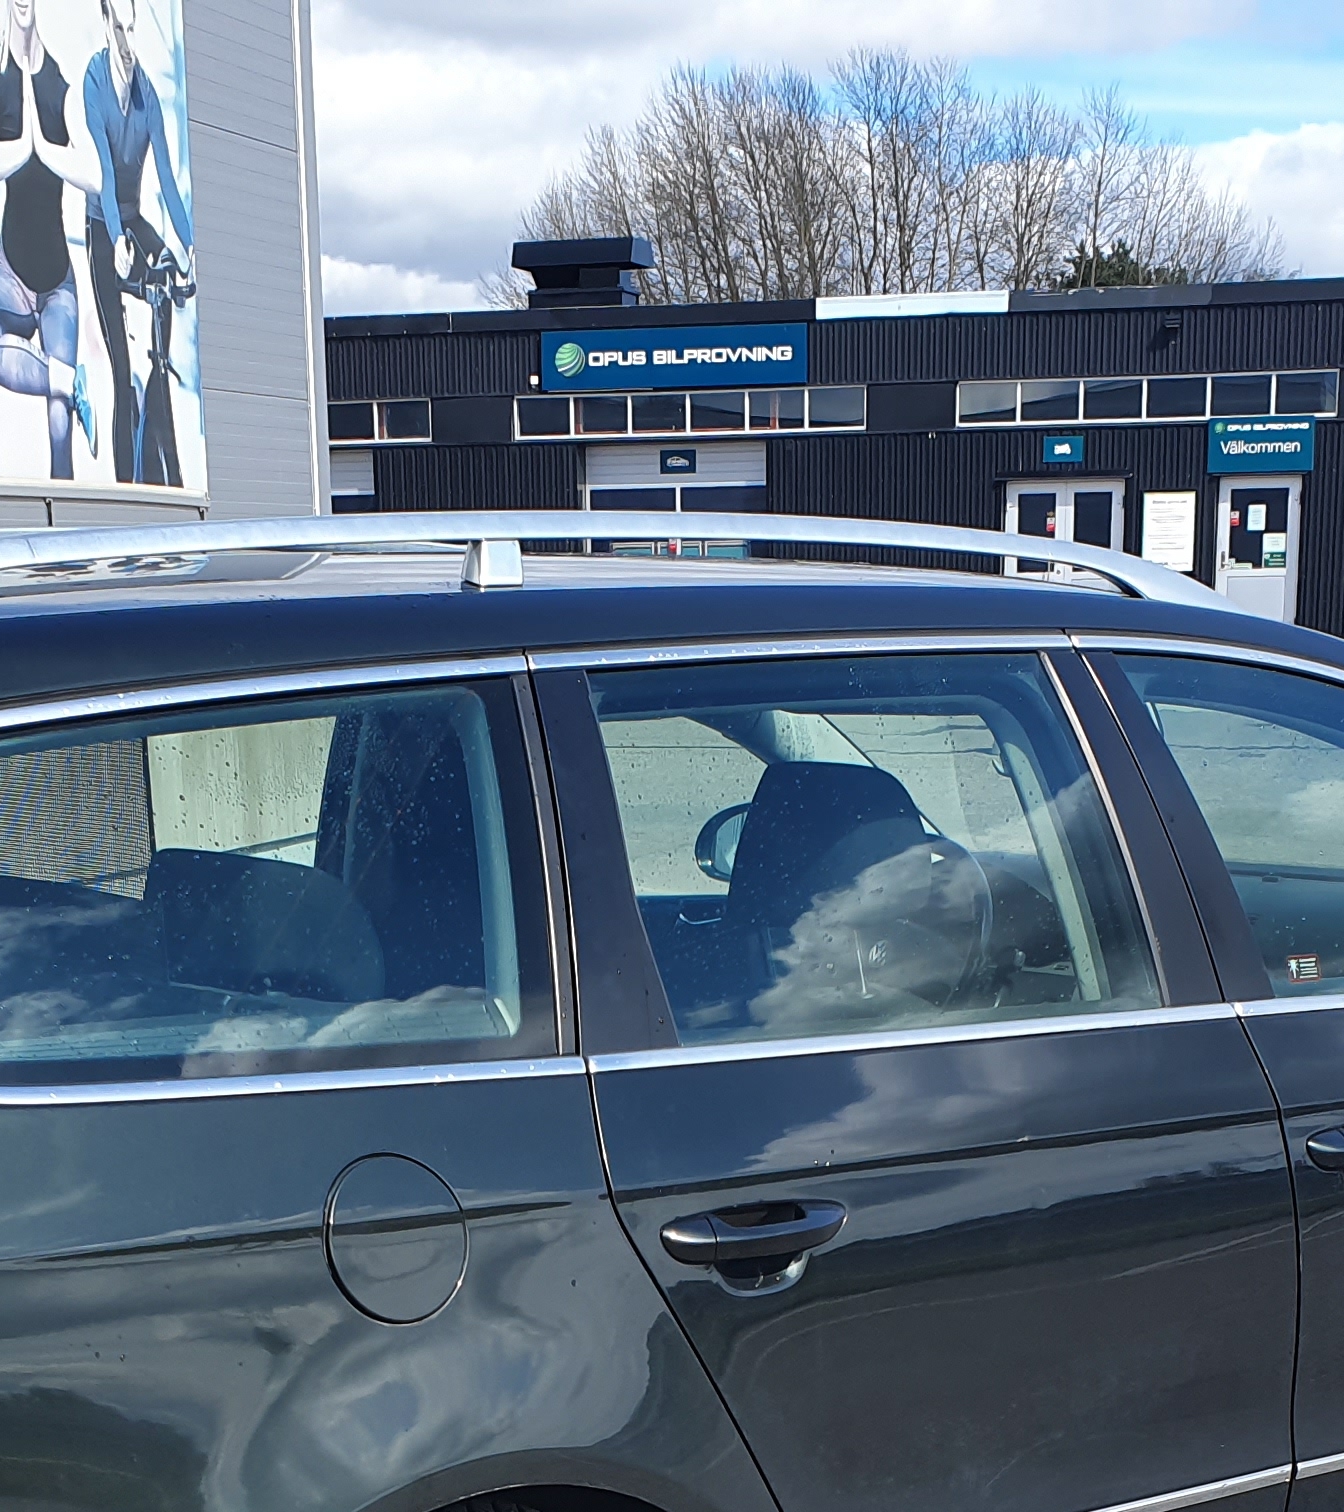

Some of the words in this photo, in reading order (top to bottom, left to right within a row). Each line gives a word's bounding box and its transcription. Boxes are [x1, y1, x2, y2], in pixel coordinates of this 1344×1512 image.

[588, 351, 647, 367] OPUS
[652, 345, 794, 365] BILPROVNING
[1220, 440, 1301, 455] Välkommen
